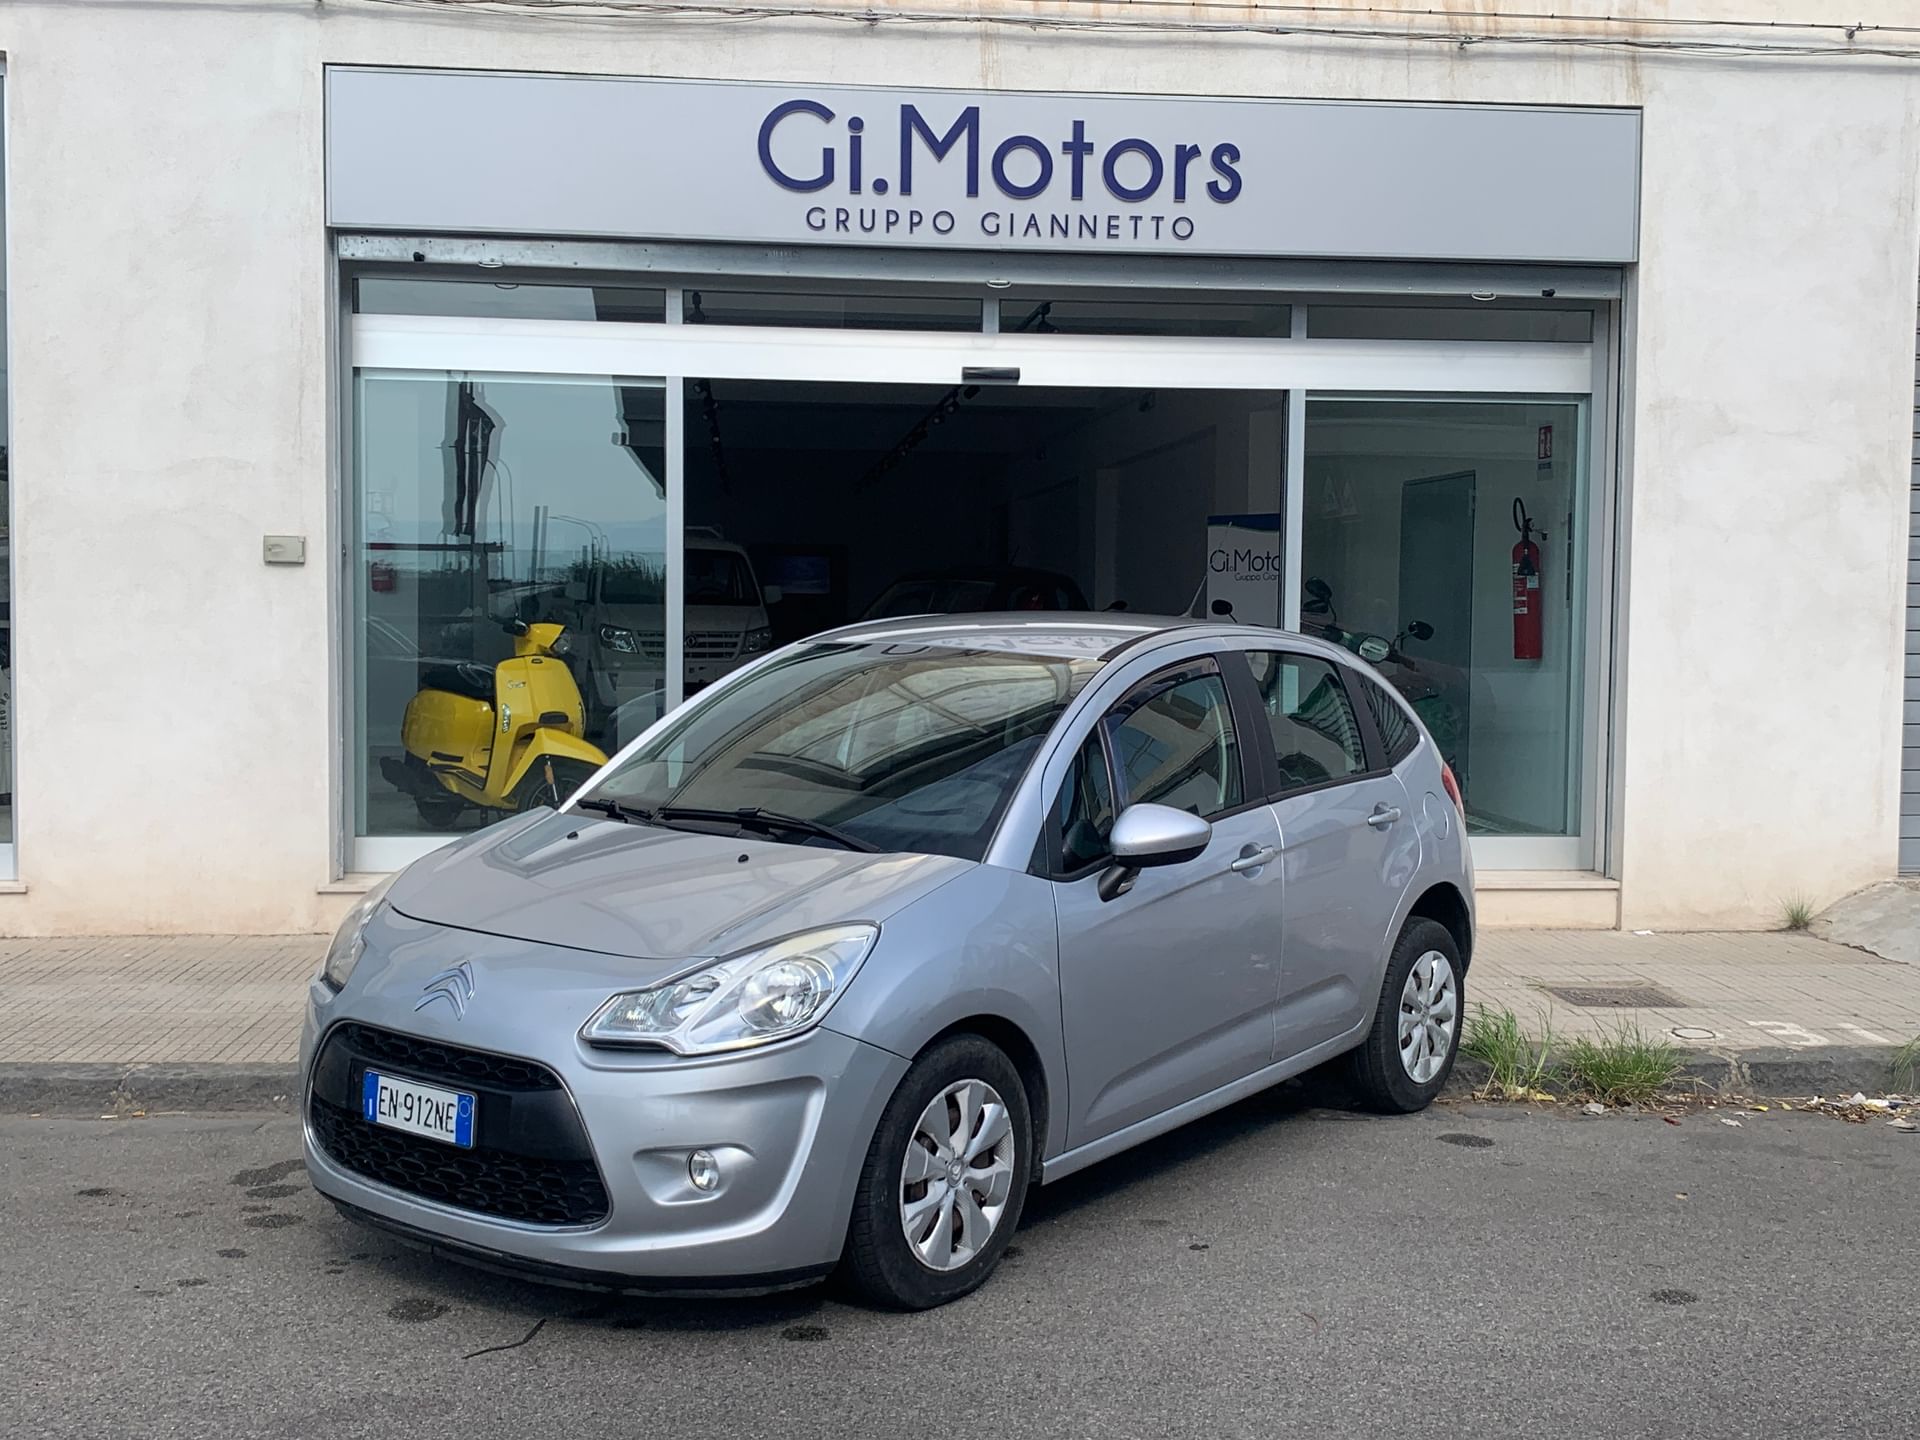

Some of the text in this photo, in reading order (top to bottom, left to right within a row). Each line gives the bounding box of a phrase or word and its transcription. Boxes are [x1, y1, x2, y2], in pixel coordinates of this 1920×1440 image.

[758, 99, 1243, 204] Gi.Motors
[805, 206, 1196, 240] GRUPPO GIANNETTO
